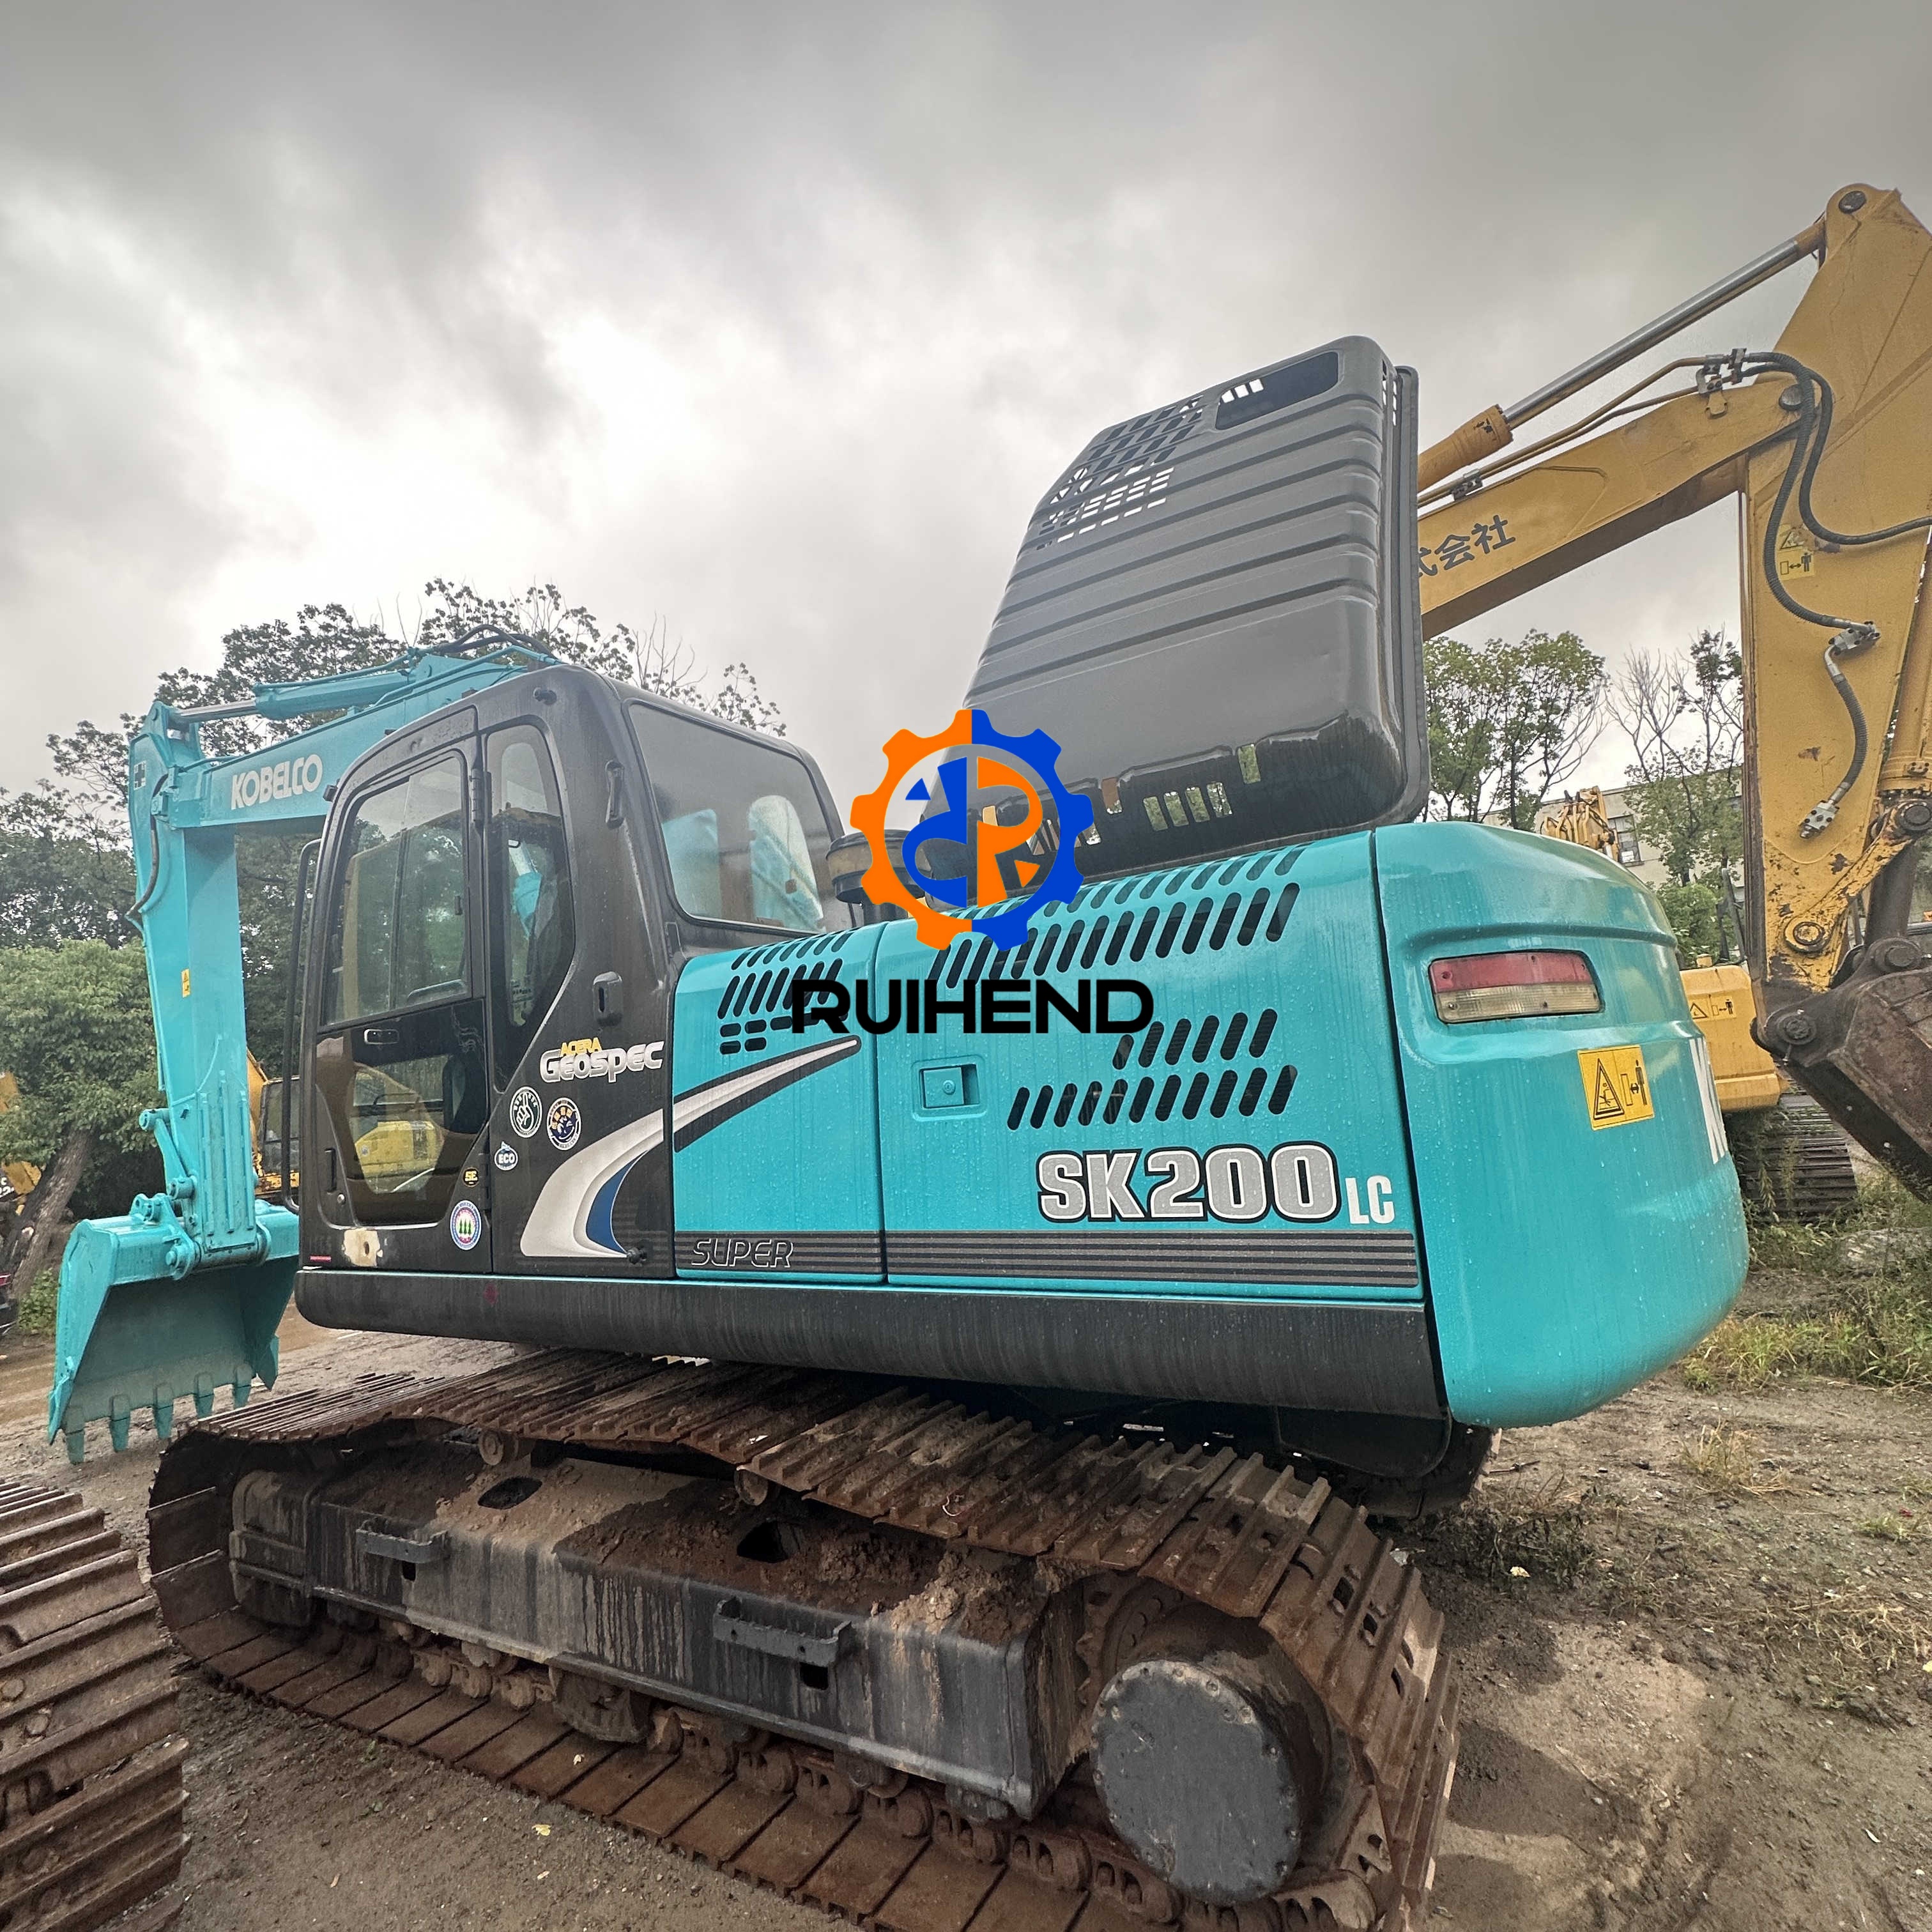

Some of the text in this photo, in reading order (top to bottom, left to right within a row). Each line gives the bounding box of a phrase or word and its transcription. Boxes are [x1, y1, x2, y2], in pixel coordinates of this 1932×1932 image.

[232, 755, 323, 809] KOBELCO
[498, 1153, 515, 1164] ECO
[1037, 1140, 1395, 1225] SK200 LC
[691, 1237, 794, 1268] SUPER
